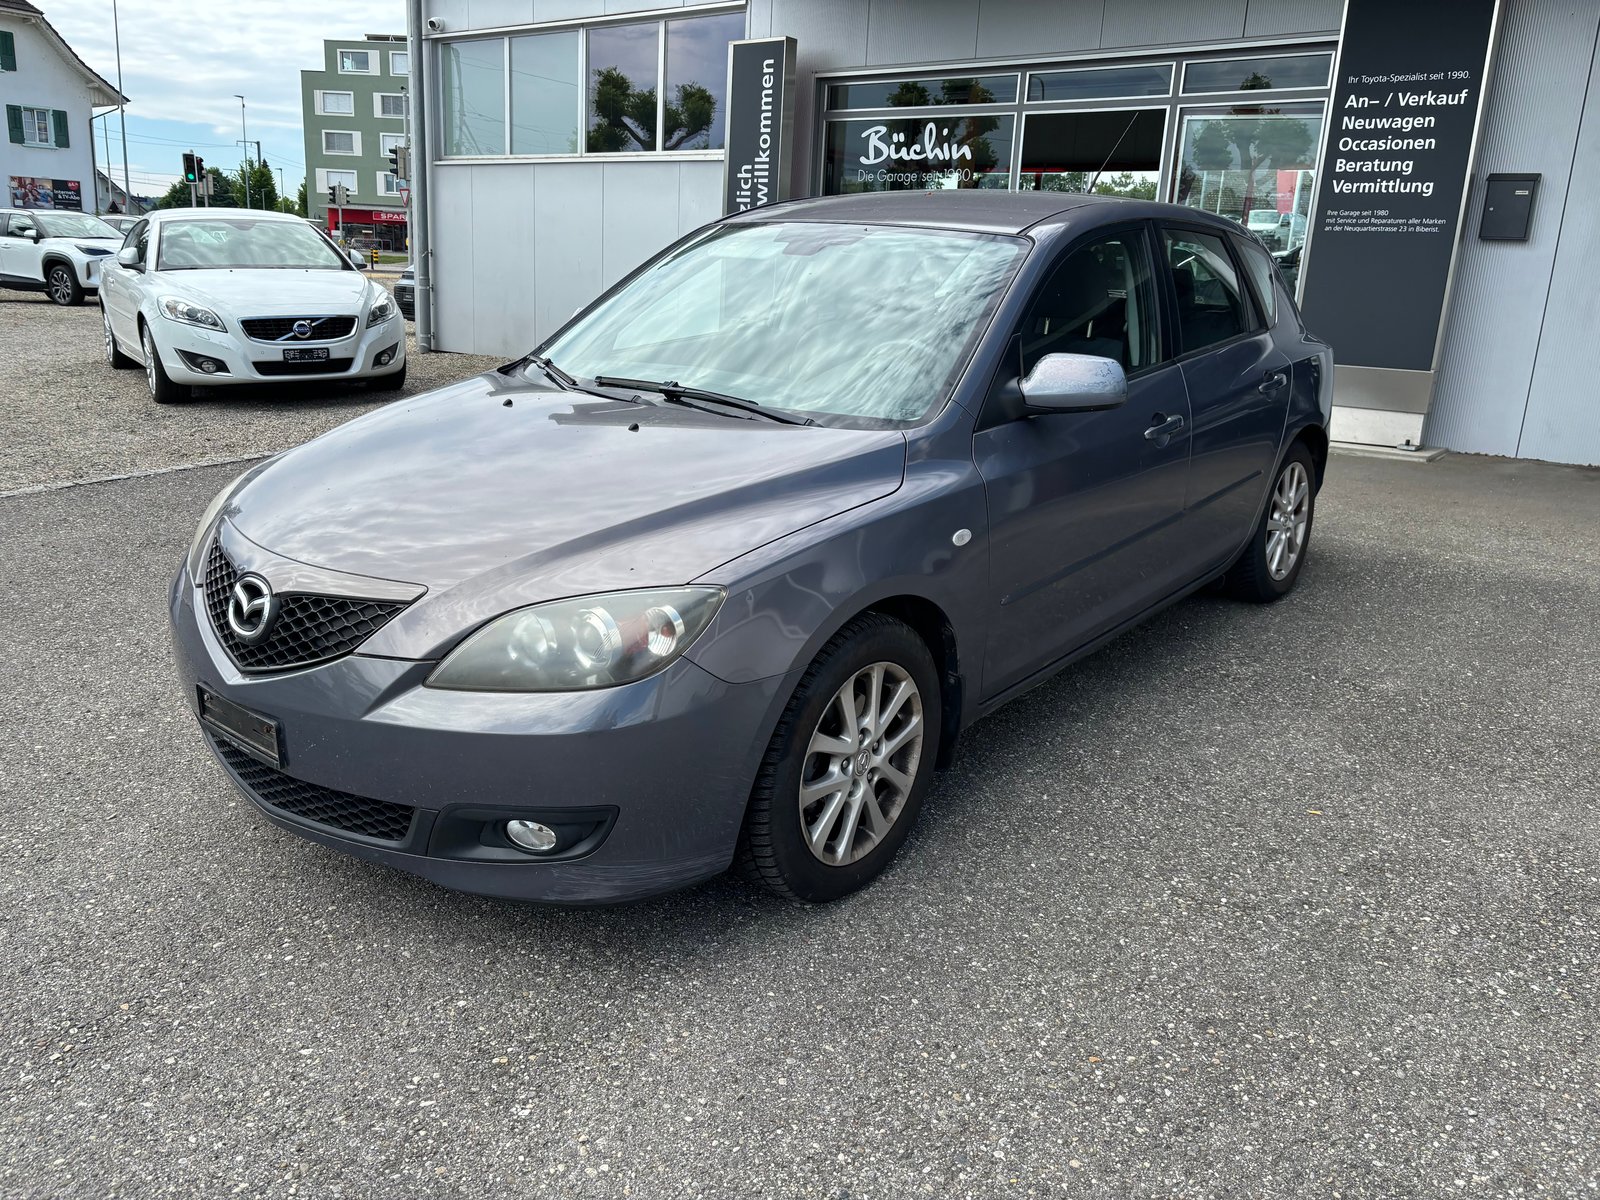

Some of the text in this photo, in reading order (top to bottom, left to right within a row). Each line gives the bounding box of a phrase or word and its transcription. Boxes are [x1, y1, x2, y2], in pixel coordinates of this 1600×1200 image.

[1348, 70, 1471, 85] Ihr Toyota-Spezialist seit 1990.
[1384, 92, 1394, 108] /
[1398, 89, 1469, 107] Verkauf
[754, 58, 775, 206] willkommen
[1342, 116, 1435, 132] Neuwagen
[859, 122, 972, 165] Büchin
[1339, 136, 1436, 151] Occasionen
[1335, 158, 1414, 175] Beratung
[858, 169, 874, 182] Die
[877, 169, 918, 185] Garage
[1332, 179, 1434, 197] Vermittlung
[1344, 225, 1398, 233] Neuquartierstrasse
